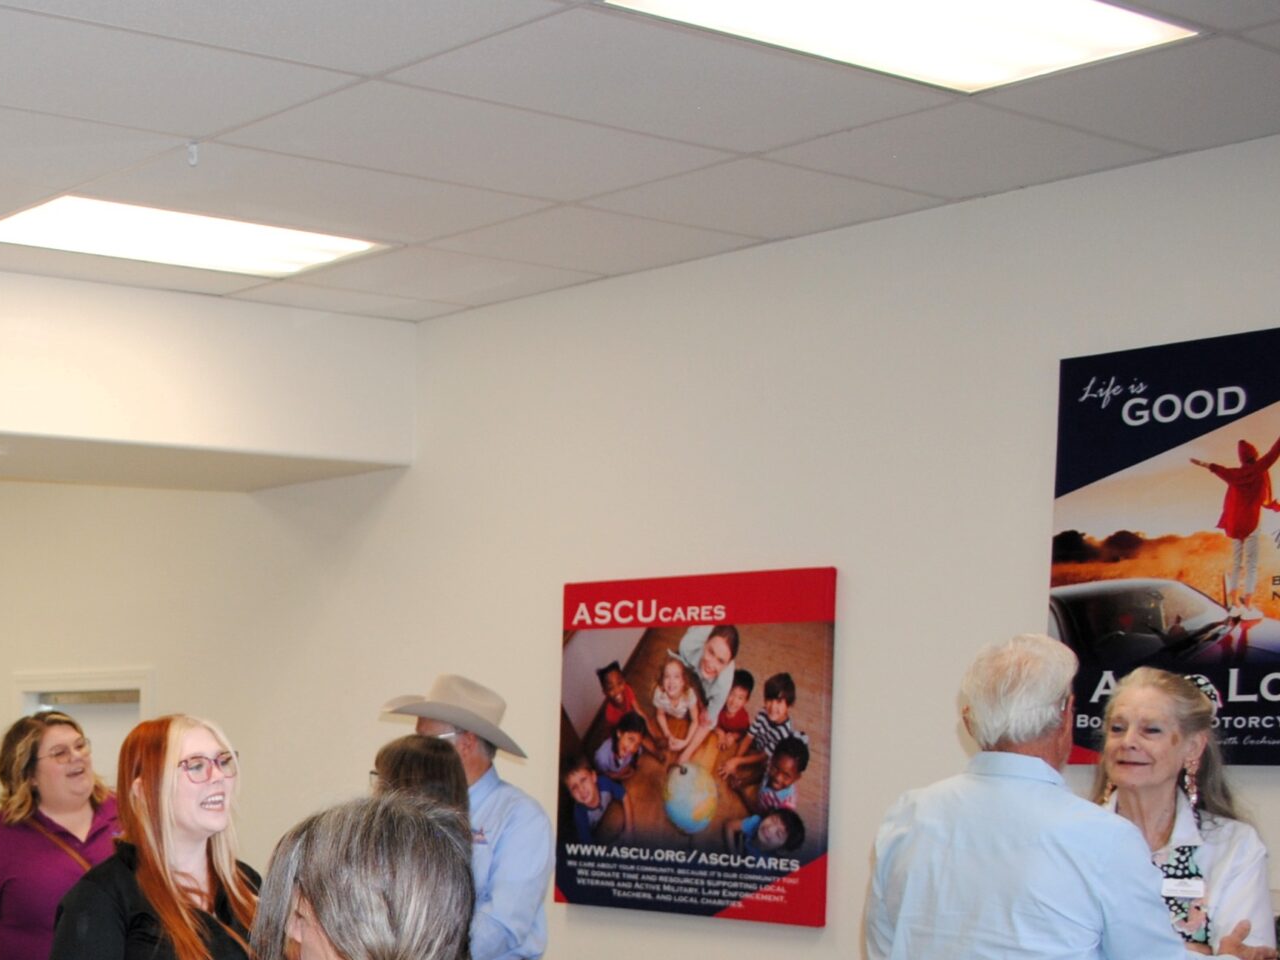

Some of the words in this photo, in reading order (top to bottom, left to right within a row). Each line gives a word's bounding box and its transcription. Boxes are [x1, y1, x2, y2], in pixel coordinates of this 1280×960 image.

[1078, 376, 1123, 409] Life
[1128, 377, 1148, 394] is
[1121, 386, 1247, 426] GOOD
[1228, 668, 1280, 702] LO
